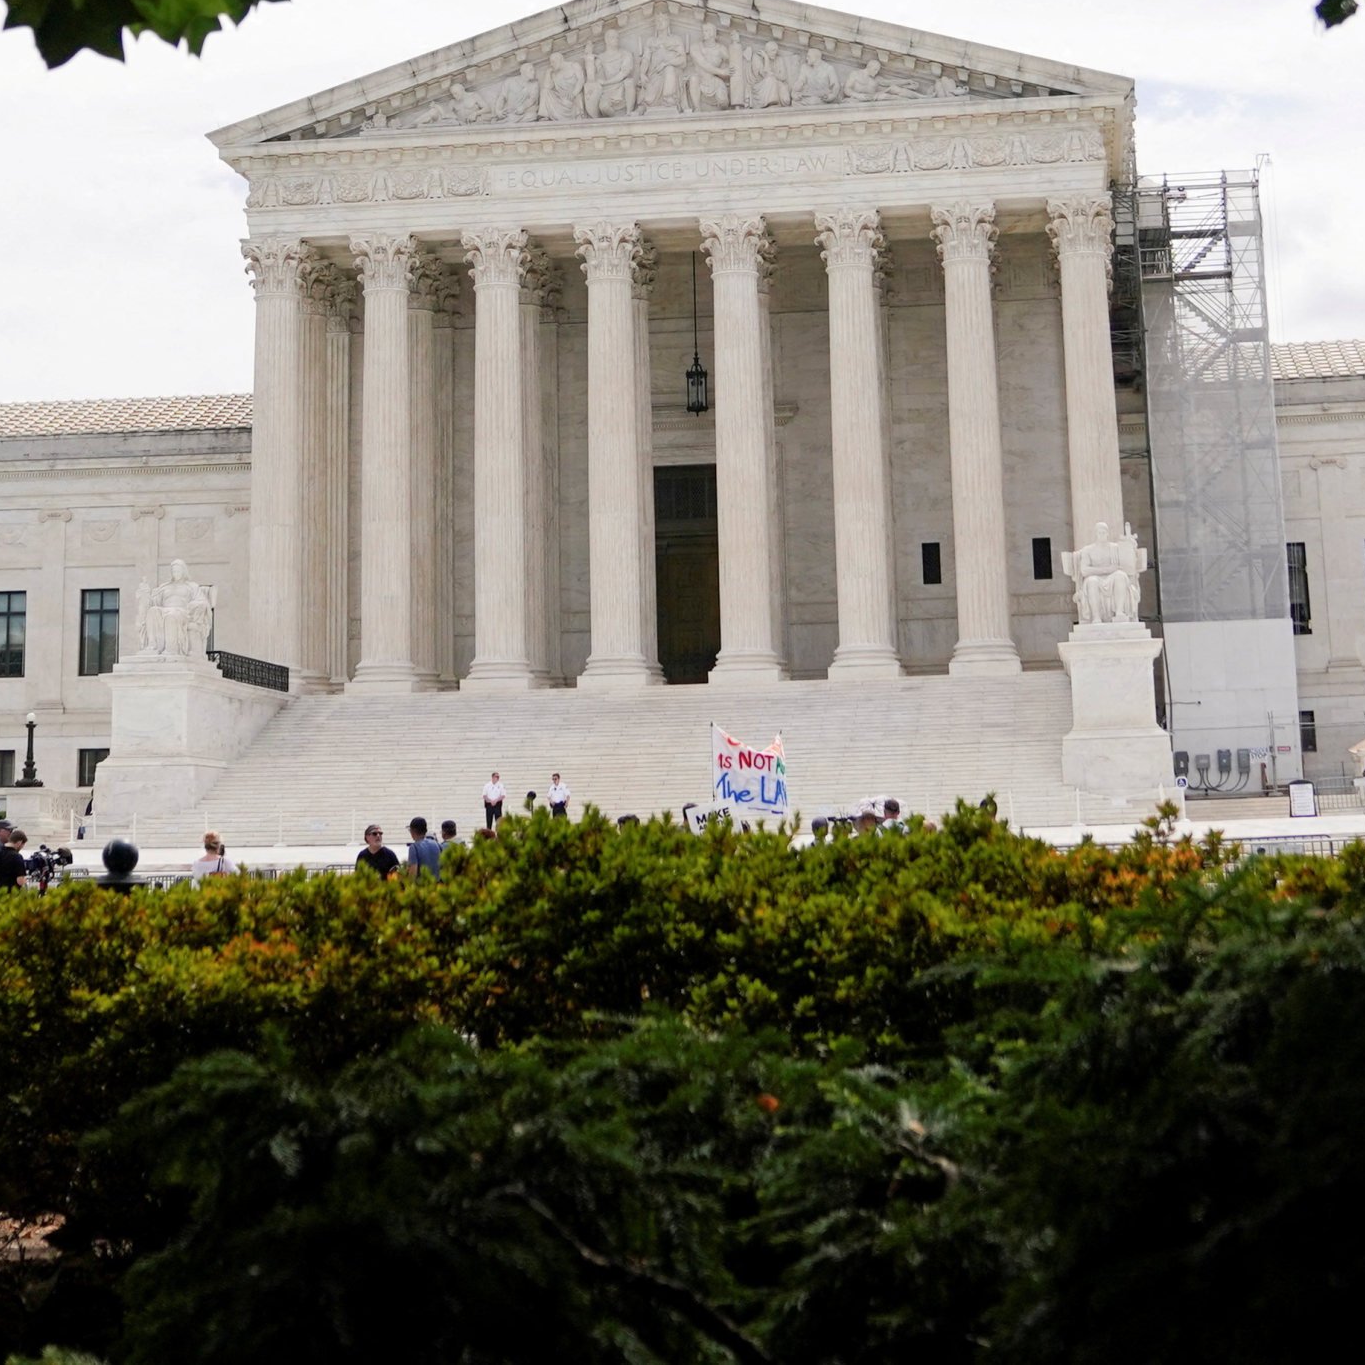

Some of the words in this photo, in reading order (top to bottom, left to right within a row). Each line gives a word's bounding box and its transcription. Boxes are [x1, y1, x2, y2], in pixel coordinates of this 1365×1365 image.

[507, 168, 585, 189] EQUAL
[591, 162, 682, 184] JUSTICE
[695, 156, 776, 178] UNDER
[783, 154, 828, 174] LAW
[738, 750, 774, 771] NOT
[716, 772, 754, 803] The
